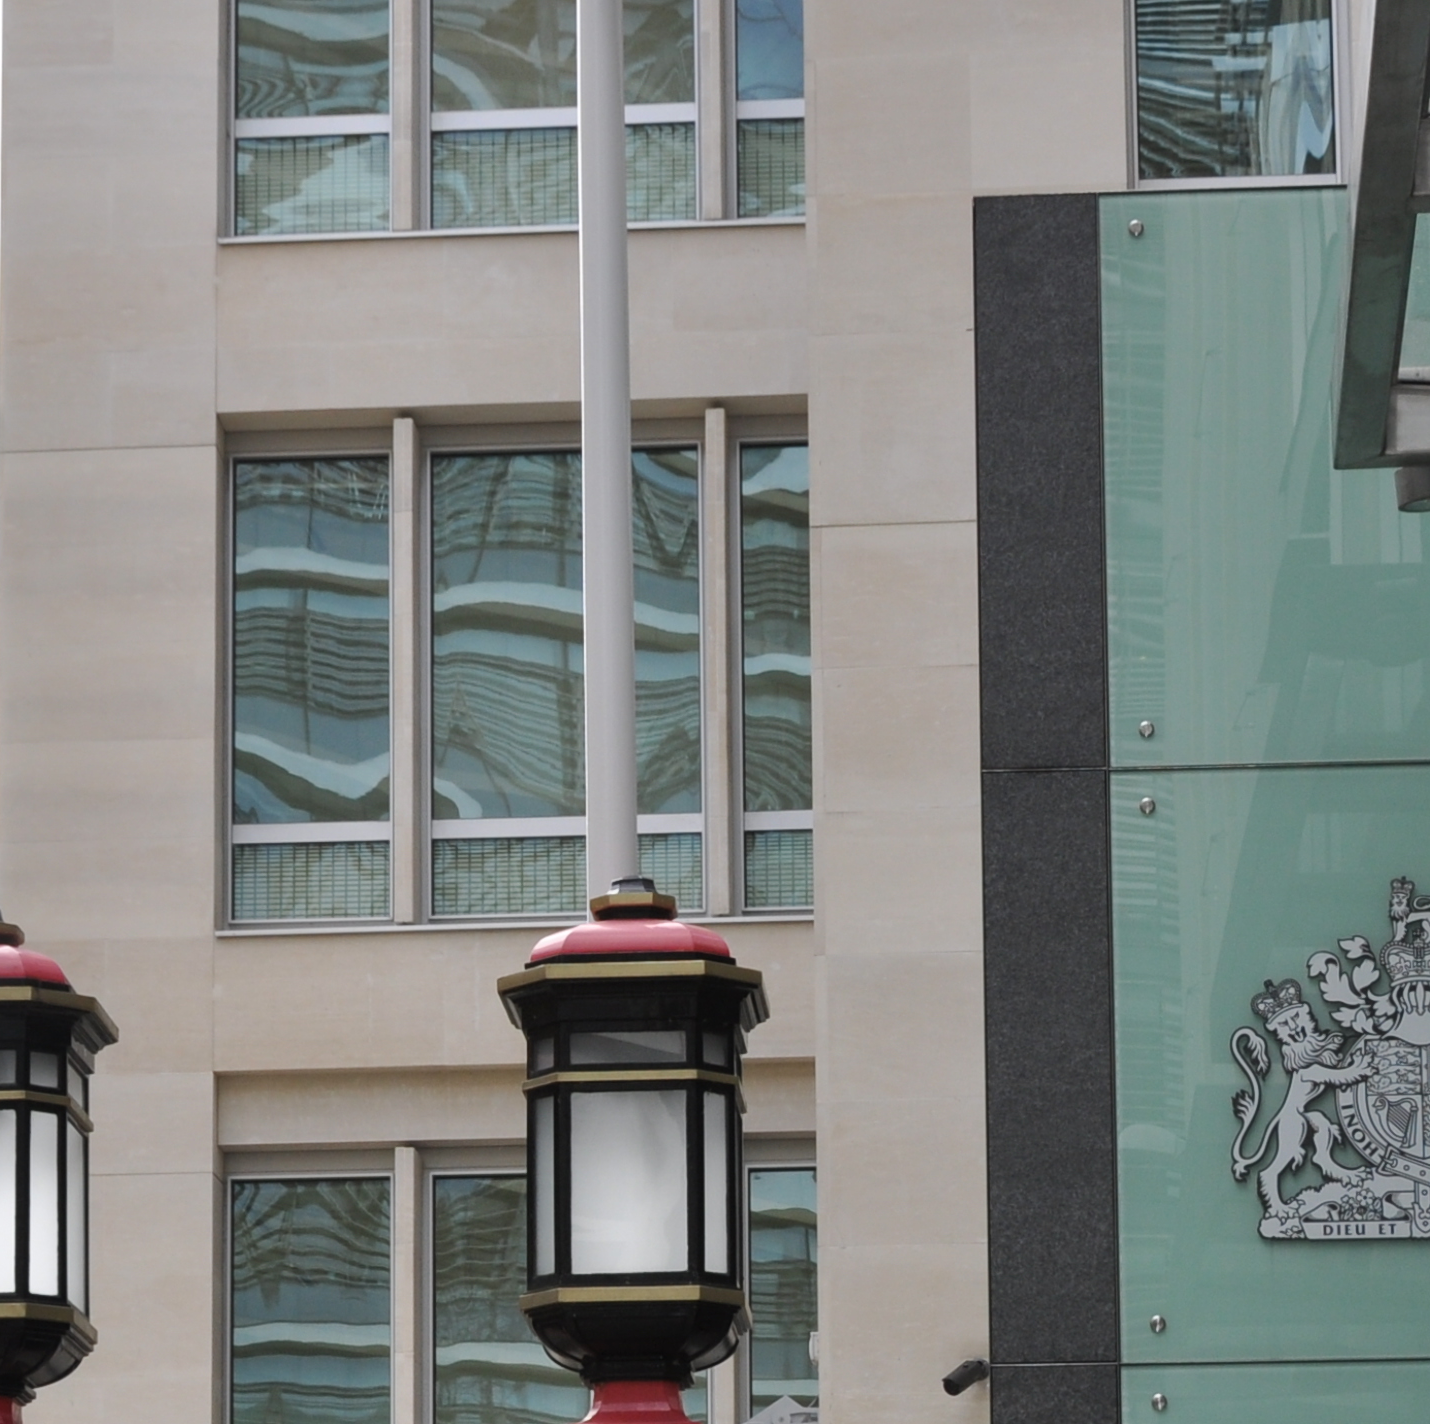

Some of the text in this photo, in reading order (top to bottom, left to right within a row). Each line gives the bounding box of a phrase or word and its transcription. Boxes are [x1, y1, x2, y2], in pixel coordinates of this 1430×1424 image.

[1341, 1104, 1380, 1161] HONI
[1323, 1224, 1366, 1236] DIEU
[1379, 1223, 1397, 1235] ET
